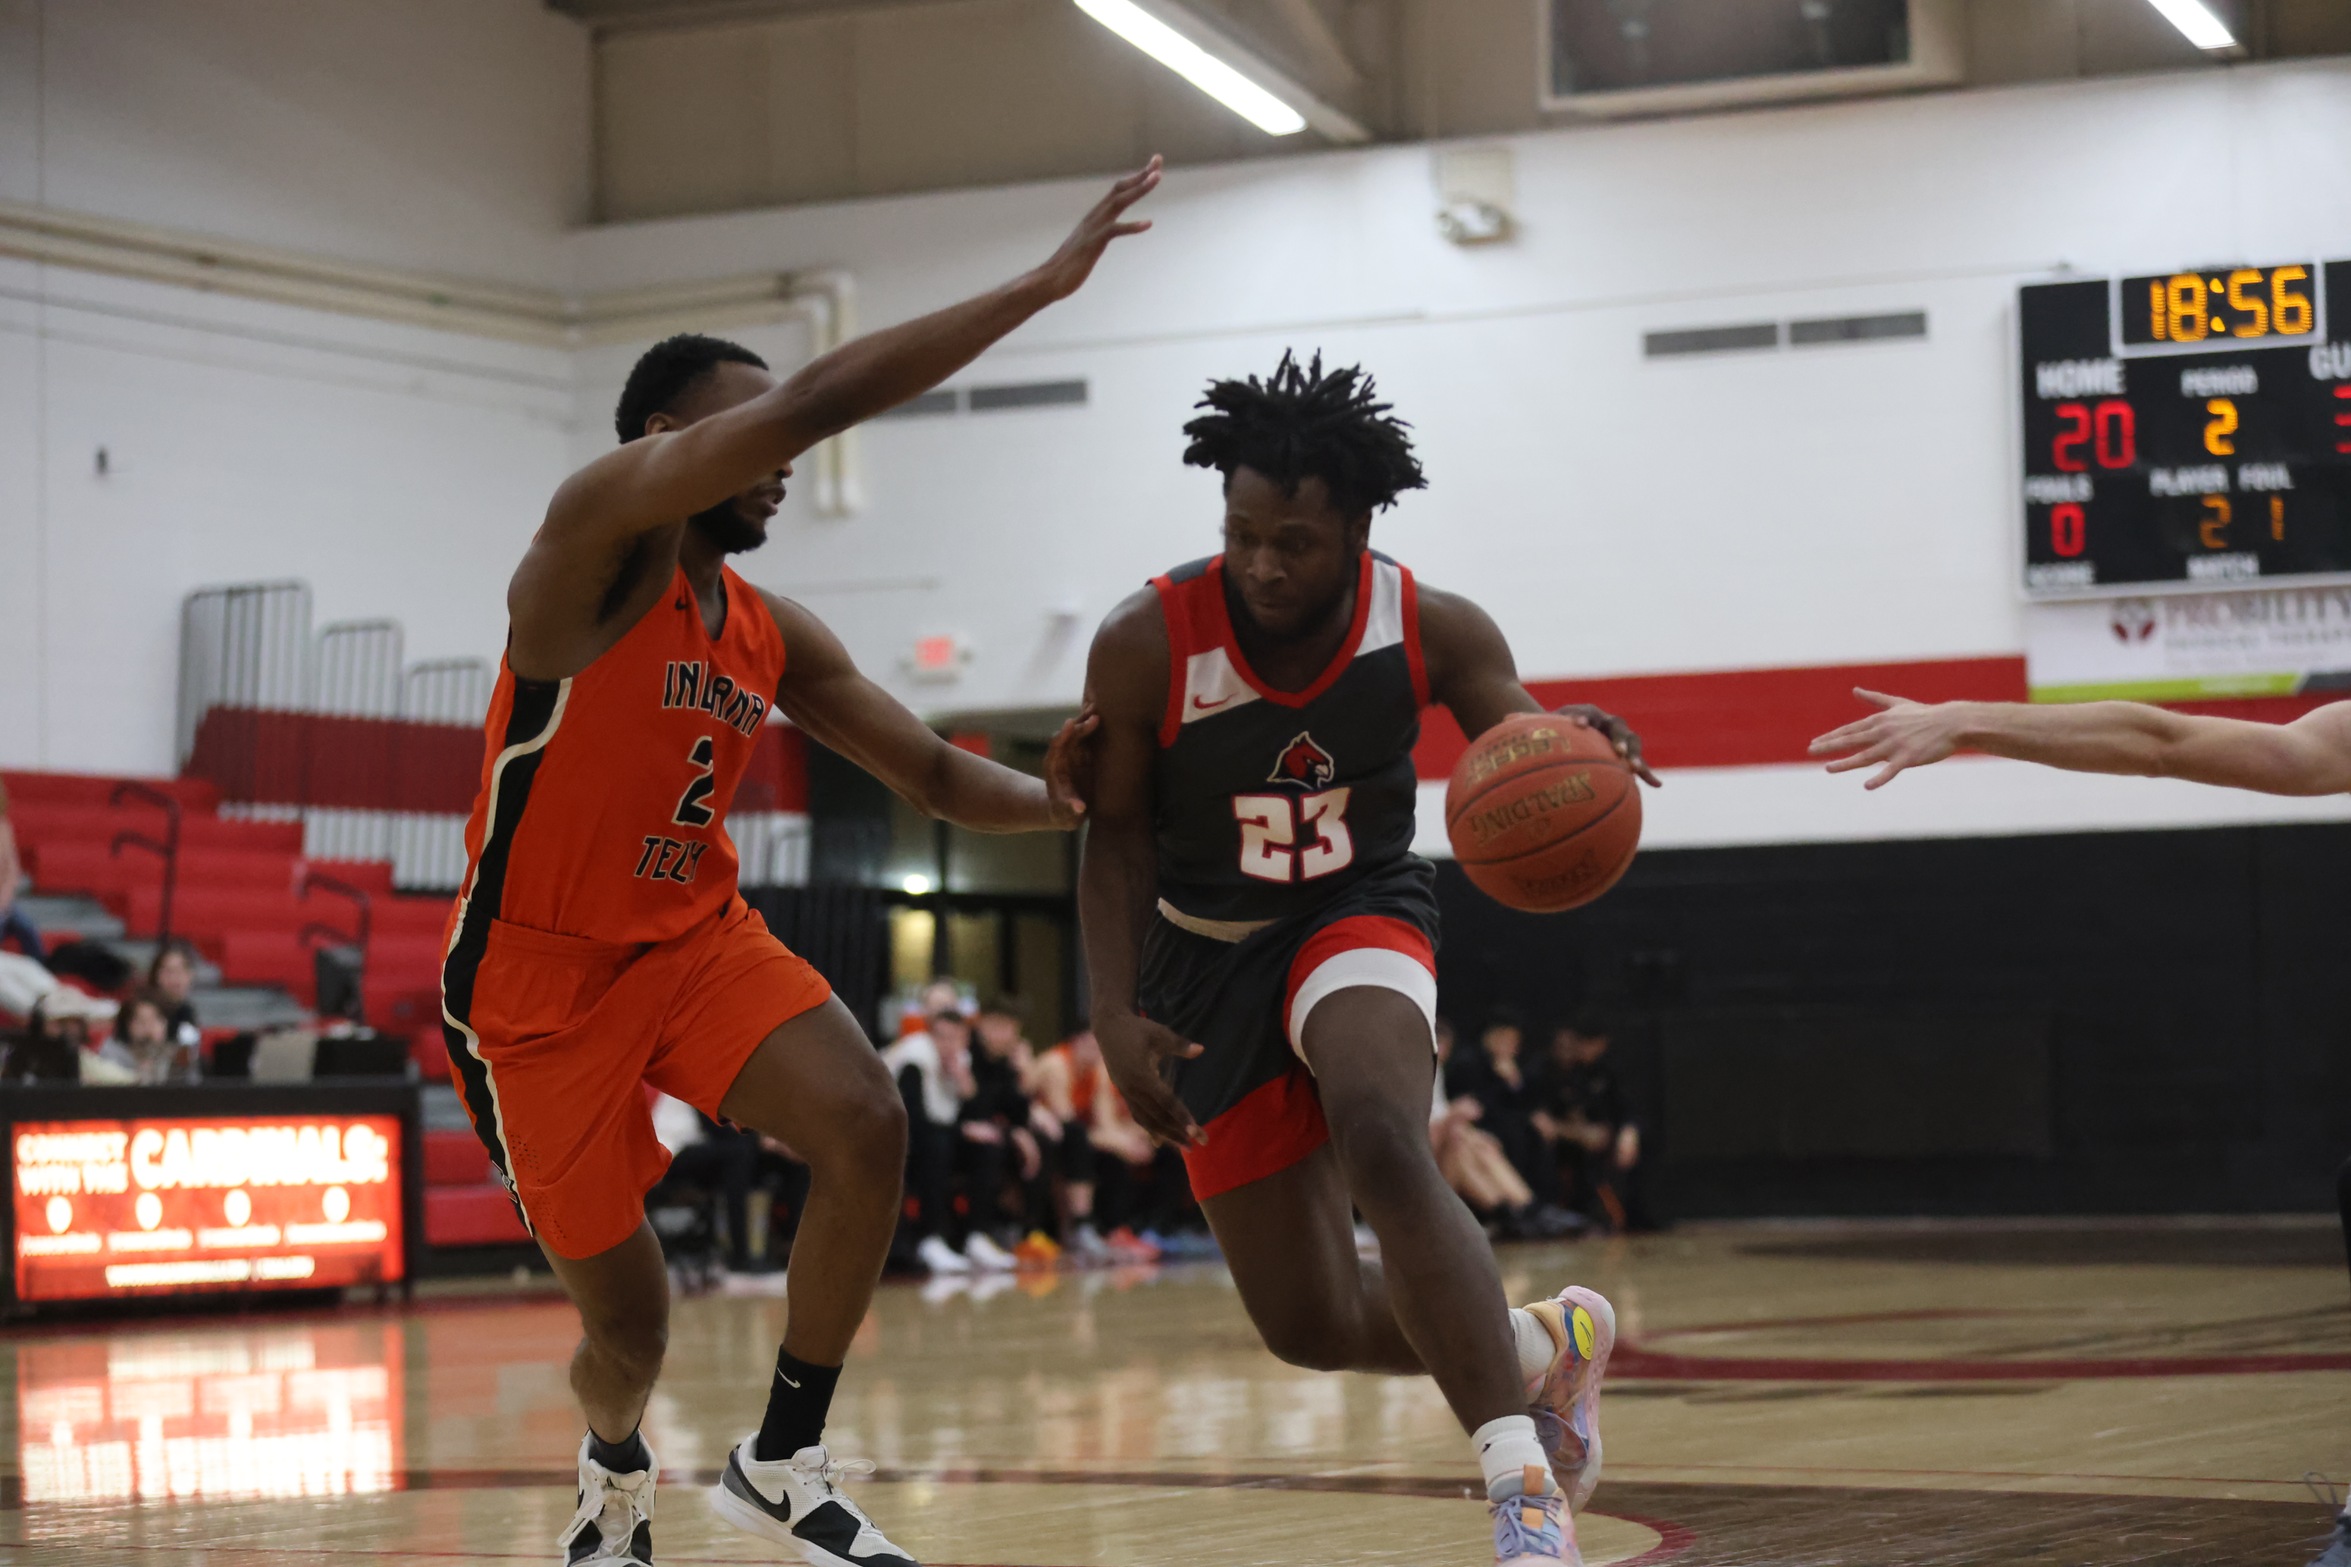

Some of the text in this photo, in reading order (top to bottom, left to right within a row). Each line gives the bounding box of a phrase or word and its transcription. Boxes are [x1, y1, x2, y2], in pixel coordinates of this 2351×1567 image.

[2150, 265, 2313, 342] 18:56
[2036, 359, 2126, 398] HOME
[2052, 400, 2136, 471] 20
[2203, 398, 2238, 456] 2
[2051, 501, 2086, 557] 0
[2200, 493, 2232, 549] 2
[662, 661, 766, 738] INANA
[671, 735, 715, 829] 2
[1470, 769, 1597, 847] SPALDING
[1232, 787, 1355, 884] 23
